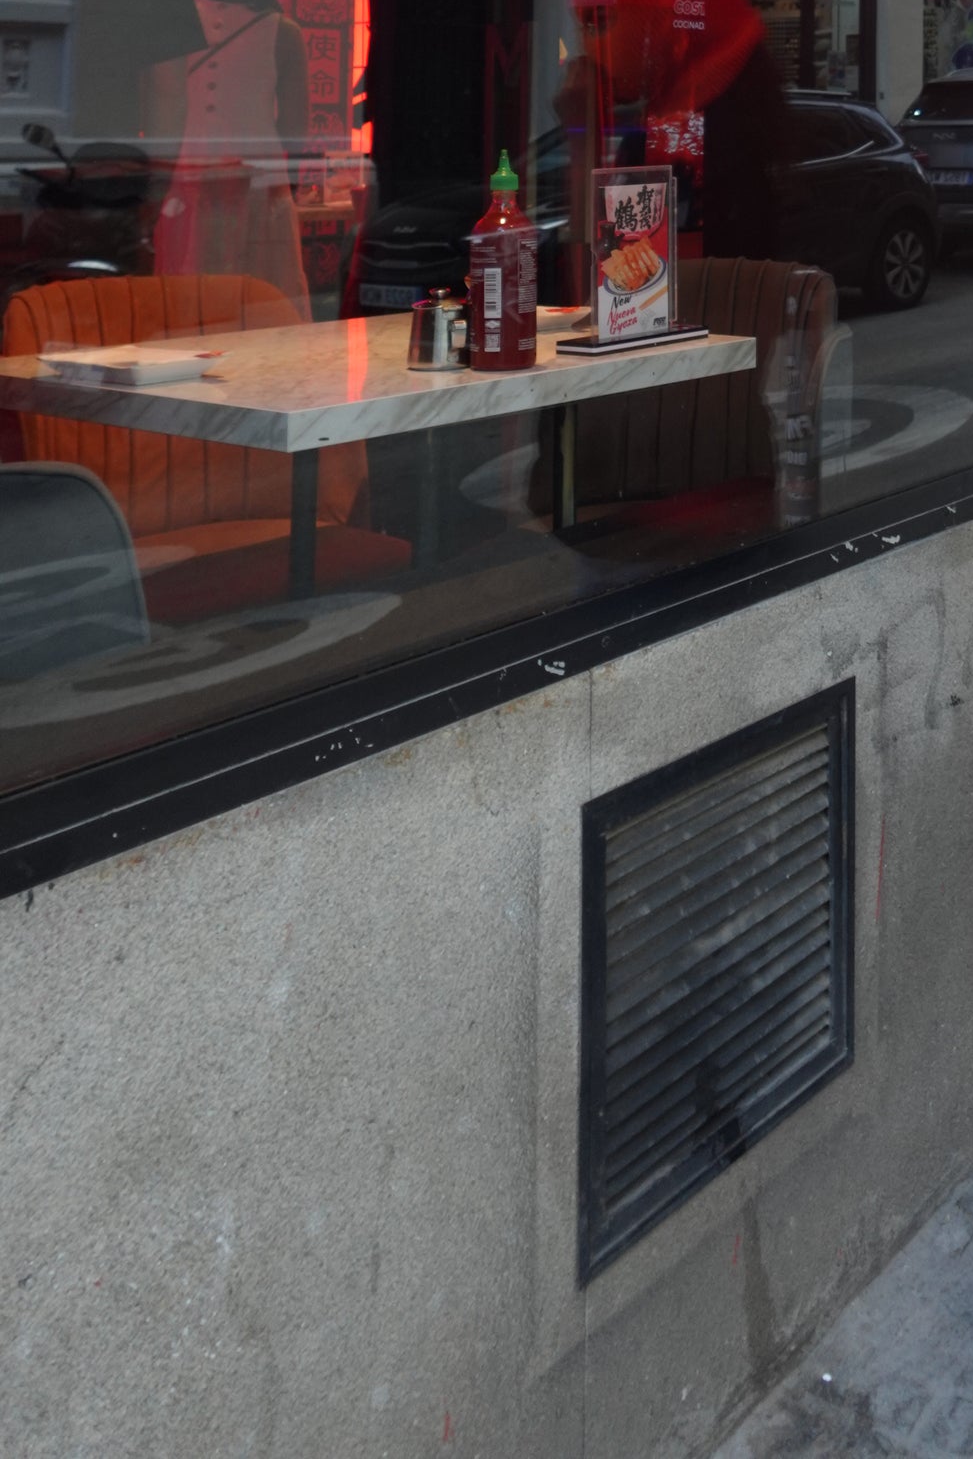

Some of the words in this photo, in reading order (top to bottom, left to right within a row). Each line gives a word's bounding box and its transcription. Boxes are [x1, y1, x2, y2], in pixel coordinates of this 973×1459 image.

[610, 294, 632, 310] New
[607, 306, 637, 326] Nueva
[609, 316, 638, 336] Gyoza
